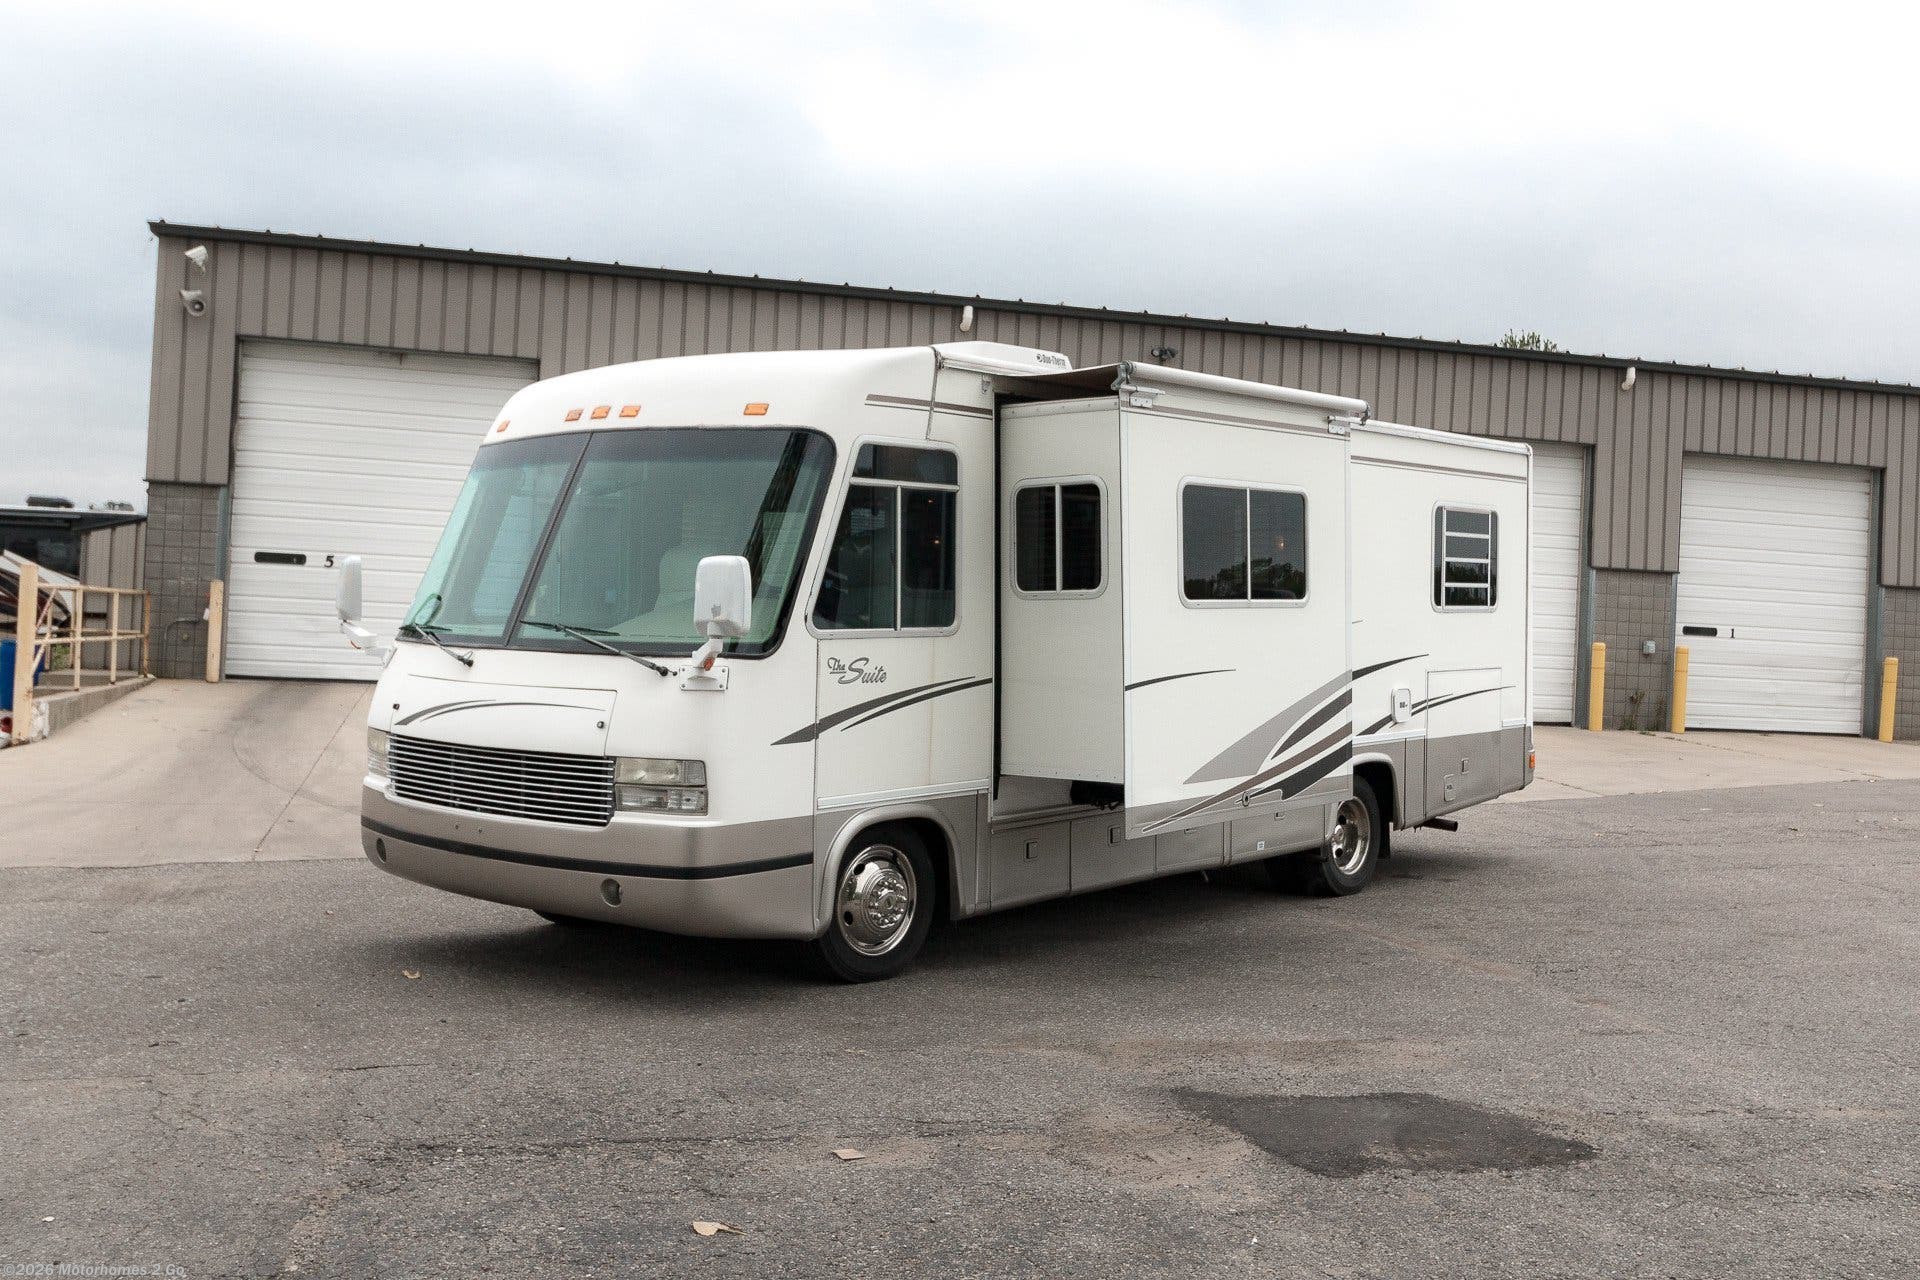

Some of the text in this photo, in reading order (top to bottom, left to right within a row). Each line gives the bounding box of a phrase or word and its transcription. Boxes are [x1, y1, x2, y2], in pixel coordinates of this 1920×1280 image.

[324, 555, 335, 568] 5
[1730, 628, 1736, 639] 1
[827, 657, 887, 684] The Suite
